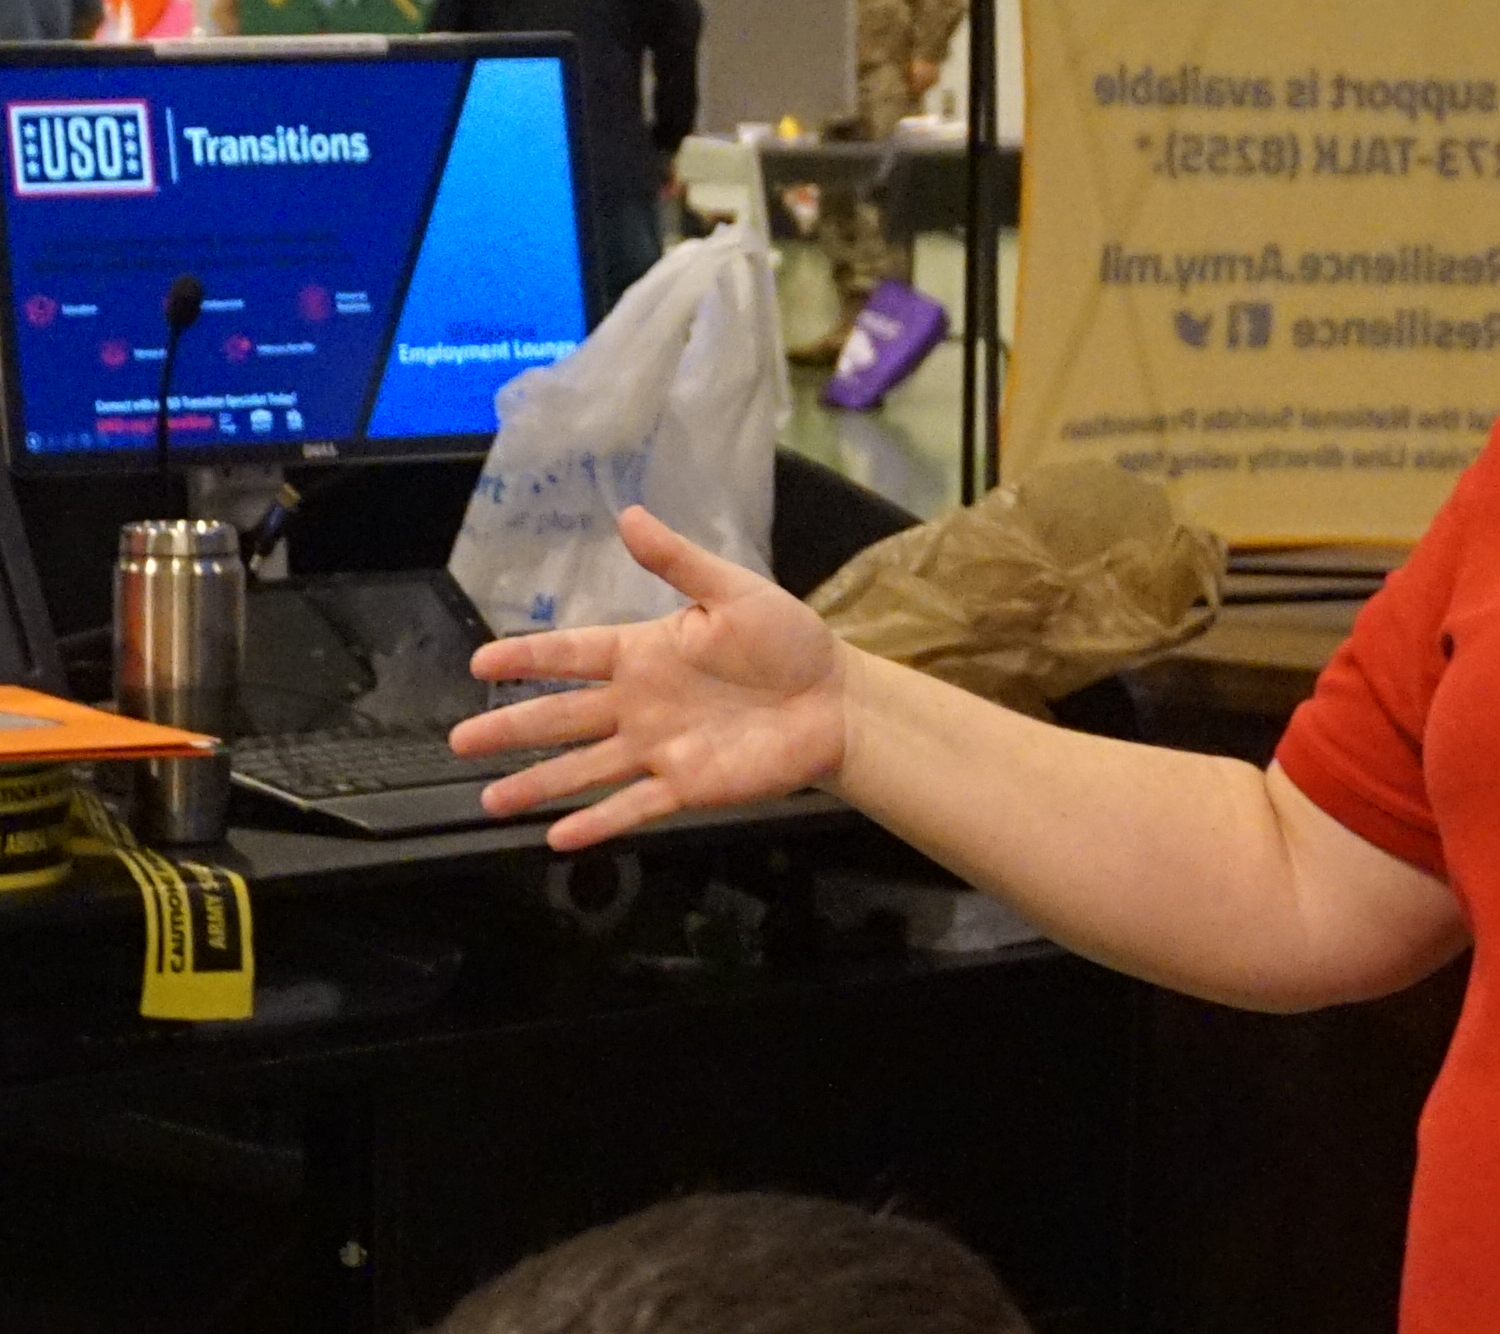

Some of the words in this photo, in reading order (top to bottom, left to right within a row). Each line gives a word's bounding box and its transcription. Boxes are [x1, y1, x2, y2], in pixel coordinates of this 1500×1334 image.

[40, 116, 123, 180] USO
[183, 121, 368, 167] Transitions
[399, 339, 511, 366] Employment
